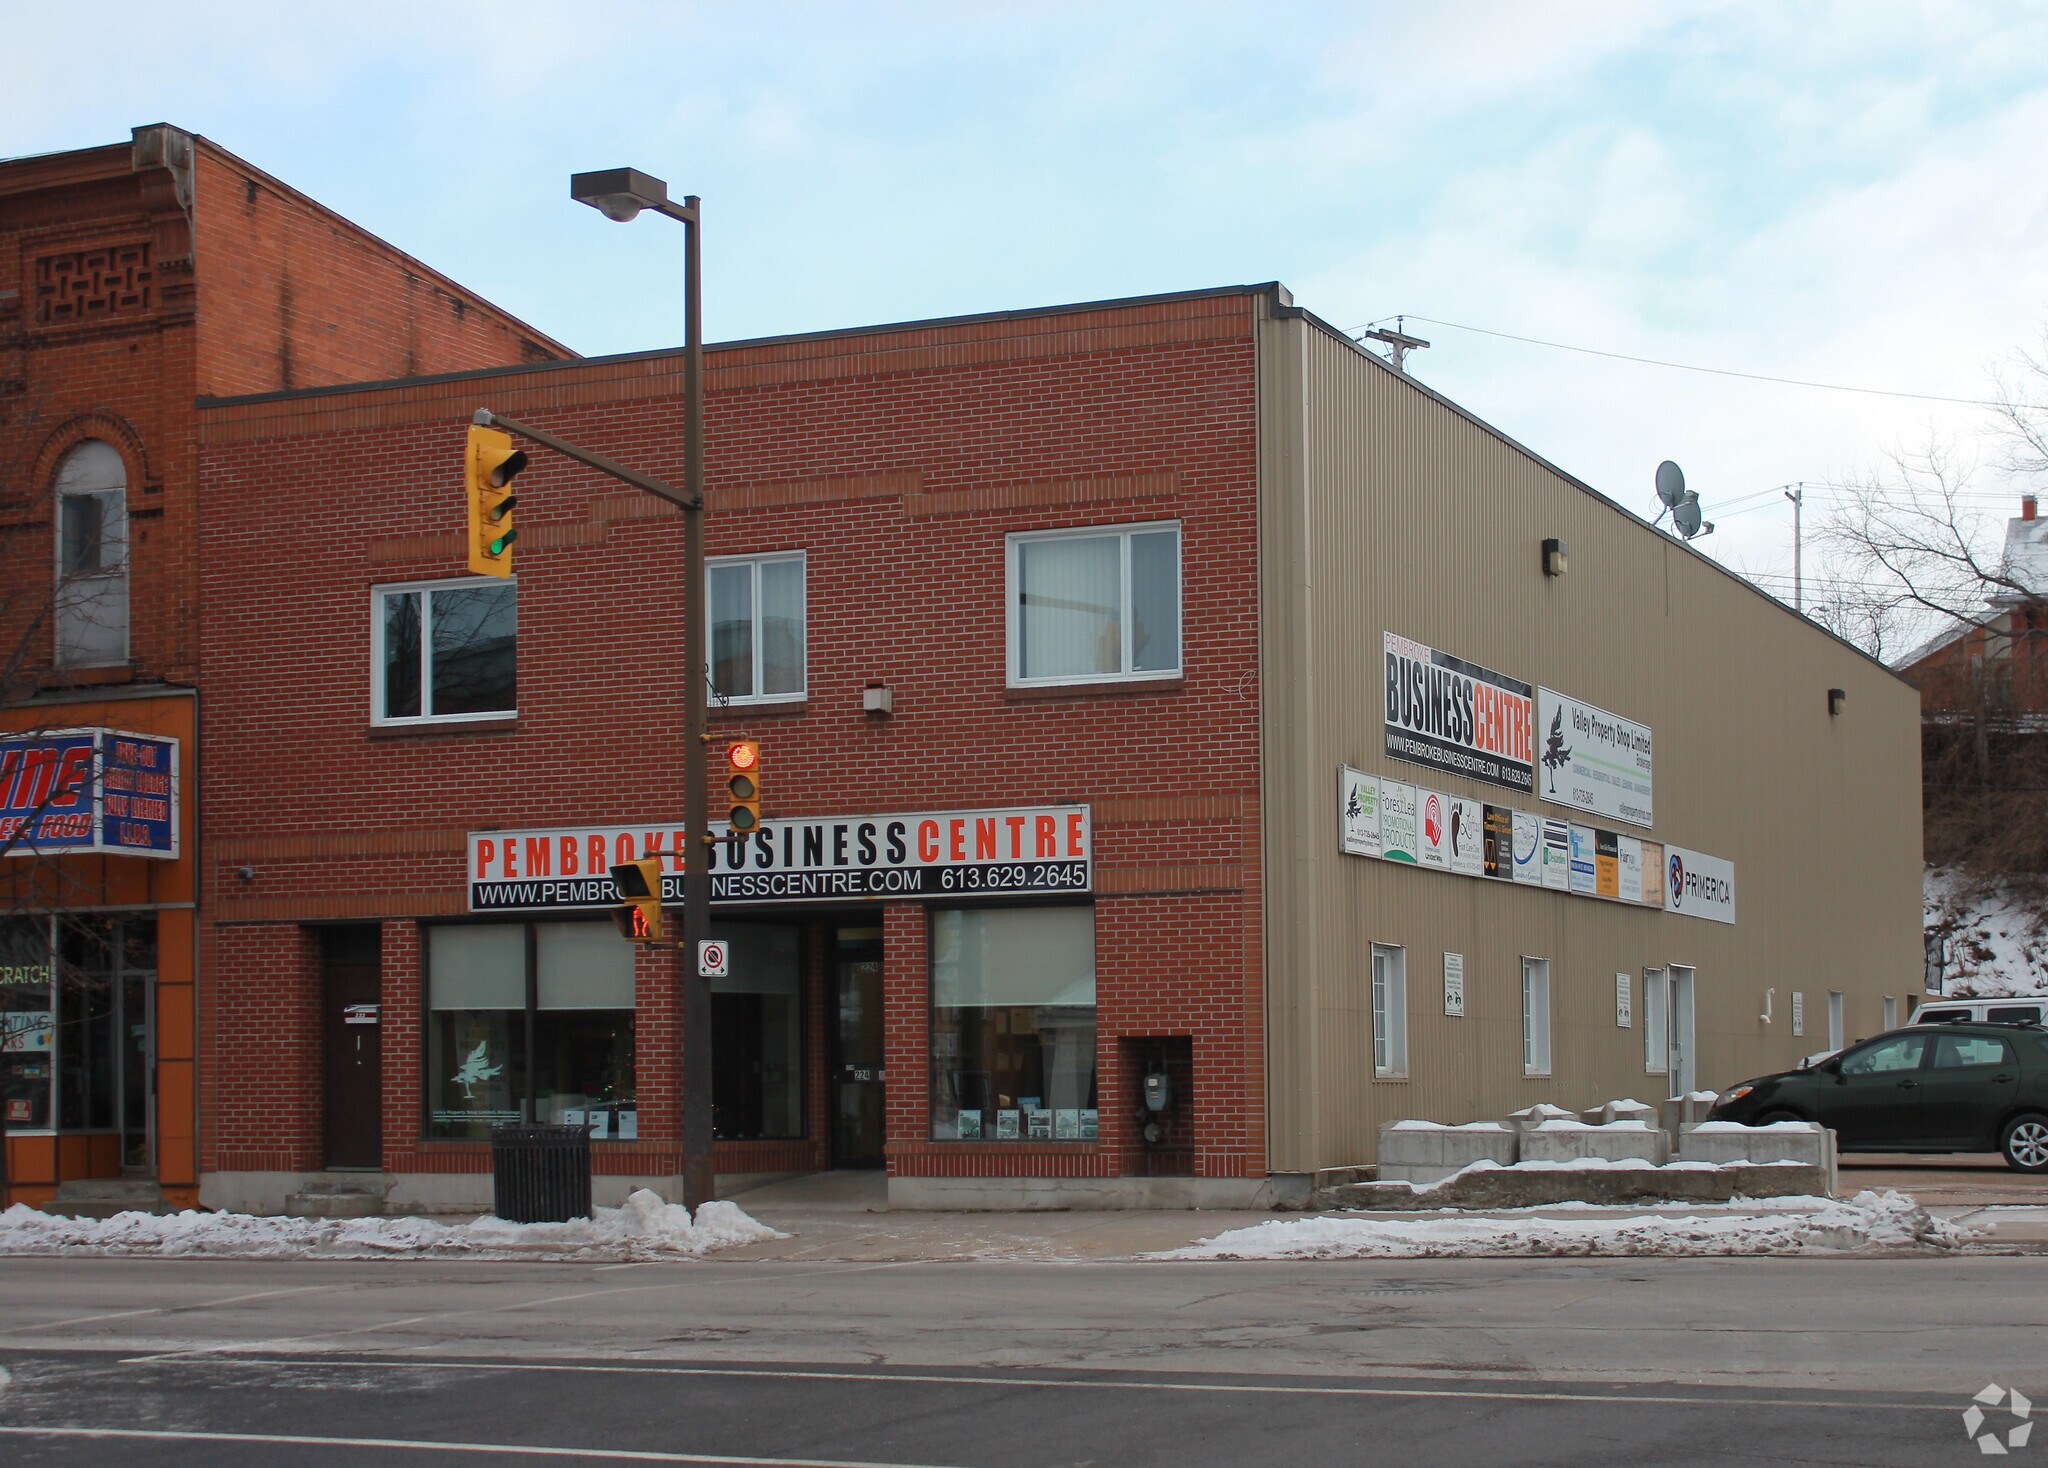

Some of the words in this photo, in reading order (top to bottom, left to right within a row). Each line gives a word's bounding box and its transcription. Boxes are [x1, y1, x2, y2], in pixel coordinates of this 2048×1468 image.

[1386, 633, 1429, 664] PEMBROKE
[1386, 652, 1474, 746] BUSINESS
[1474, 682, 1532, 762] CENTRE
[1571, 706, 1590, 739] Valley
[1592, 714, 1615, 748] Property
[1617, 724, 1630, 752] Shop
[1631, 729, 1651, 755] Limited
[1386, 733, 1500, 778] WWW.PEMBROKEBUSINESSCENTRE.COM
[37, 812, 93, 839] FOOD
[1382, 828, 1416, 850] PRODUCTS
[477, 831, 685, 878] PEMBROKE
[917, 813, 1084, 863] CENTRE
[478, 869, 921, 904] WWW.PEMBRBUNESSCENTRE.COM
[941, 864, 1085, 889] 613.629.2645
[1685, 871, 1730, 904] PRIMERICA
[855, 1071, 869, 1080] 224
